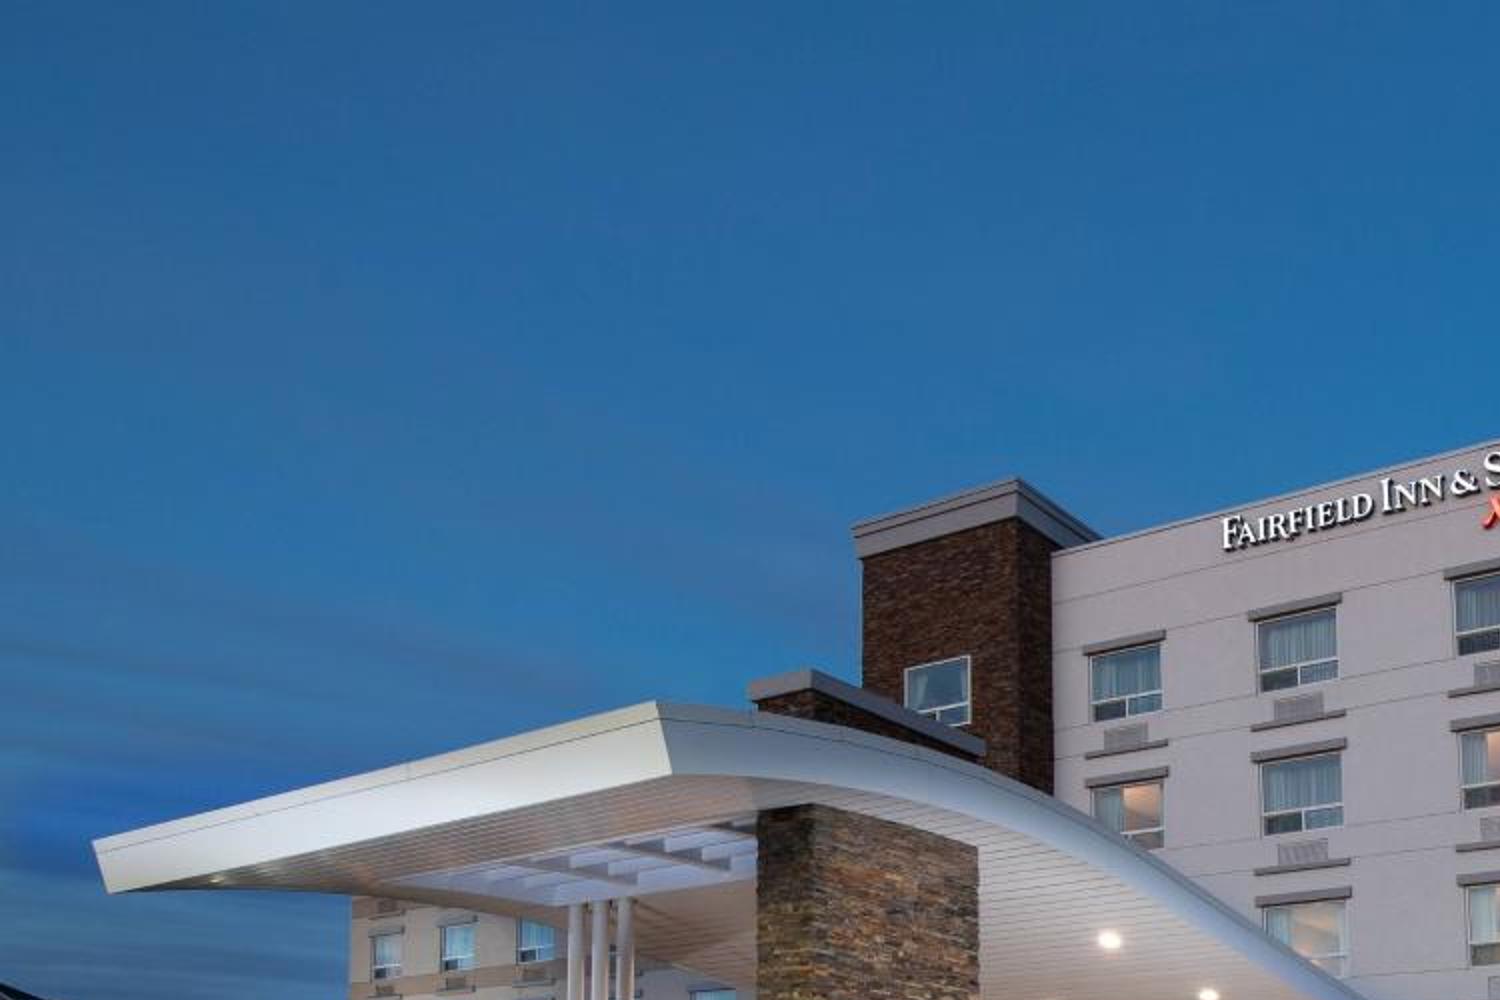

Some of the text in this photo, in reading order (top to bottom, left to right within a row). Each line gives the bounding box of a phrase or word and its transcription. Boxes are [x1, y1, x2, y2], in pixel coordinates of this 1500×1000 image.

[1221, 492, 1375, 551] FAIRFIELD
[1381, 474, 1443, 514] INN
[1450, 468, 1479, 496] &
